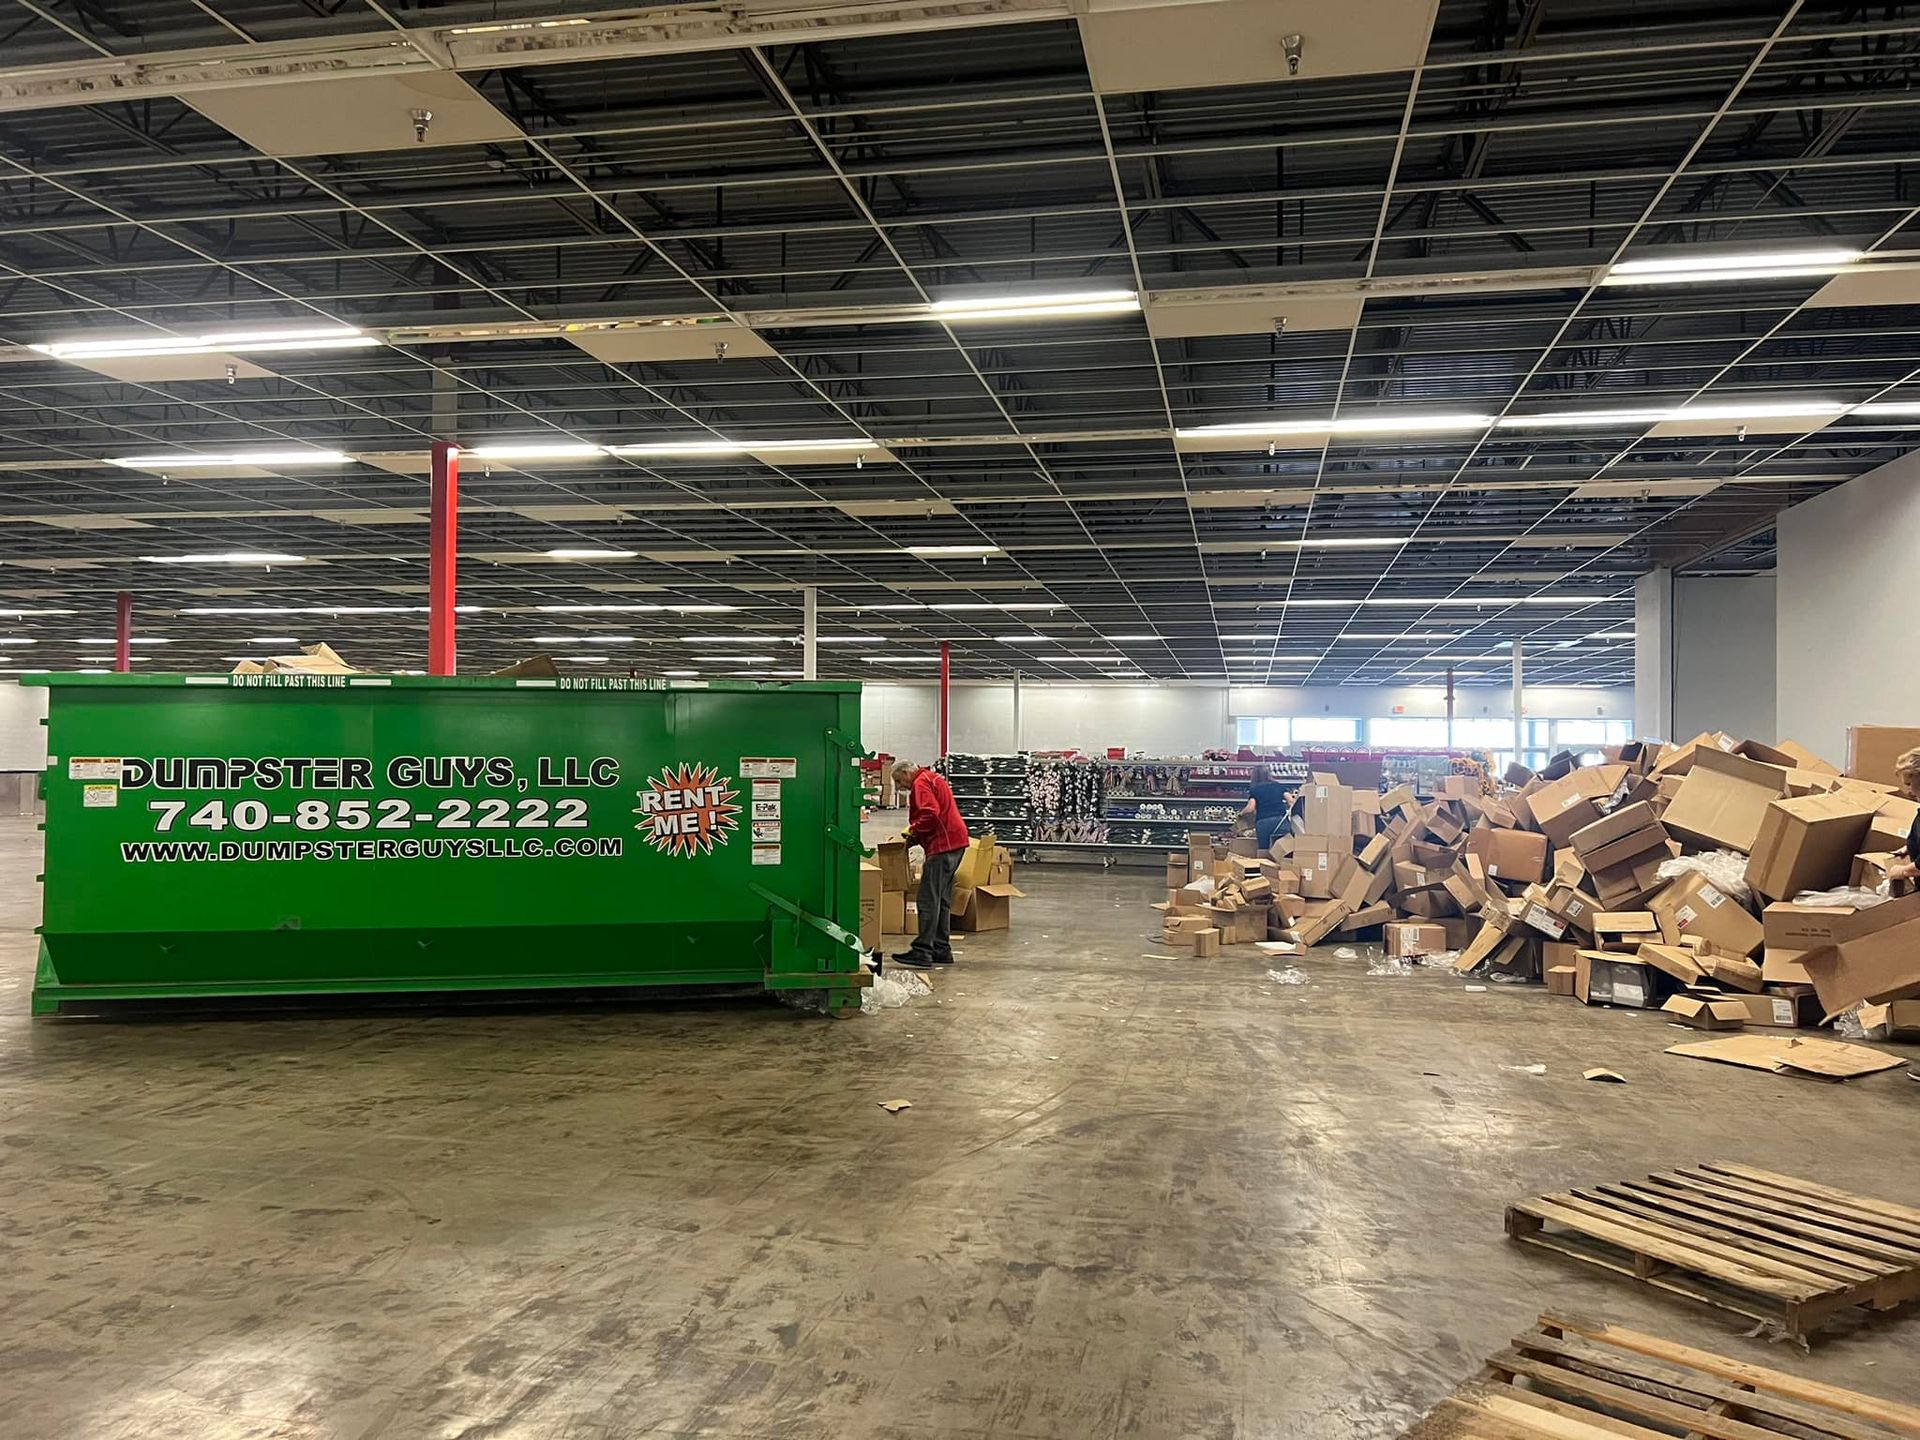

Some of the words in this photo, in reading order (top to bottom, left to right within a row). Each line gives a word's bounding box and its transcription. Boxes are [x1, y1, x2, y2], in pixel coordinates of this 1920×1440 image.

[233, 675, 244, 688] DO
[246, 675, 264, 688] NOT
[266, 675, 283, 688] FILL
[285, 675, 306, 688] PAST
[307, 675, 326, 688] THIS
[327, 675, 346, 688] LINE
[560, 678, 571, 690] DO
[573, 678, 589, 690] NOT
[591, 678, 607, 690] FILL
[609, 678, 627, 690] PAST
[630, 678, 647, 690] THIS
[649, 678, 667, 690] LINE
[120, 757, 374, 790] DUMPSTER
[387, 756, 528, 792] GUYS,
[538, 756, 620, 787] LLC
[641, 785, 724, 812] RENT
[148, 797, 590, 831] 740-852-2222
[654, 812, 699, 836] ME
[121, 837, 623, 861] WWW.DUMPSTERGUYSLLC.COM
